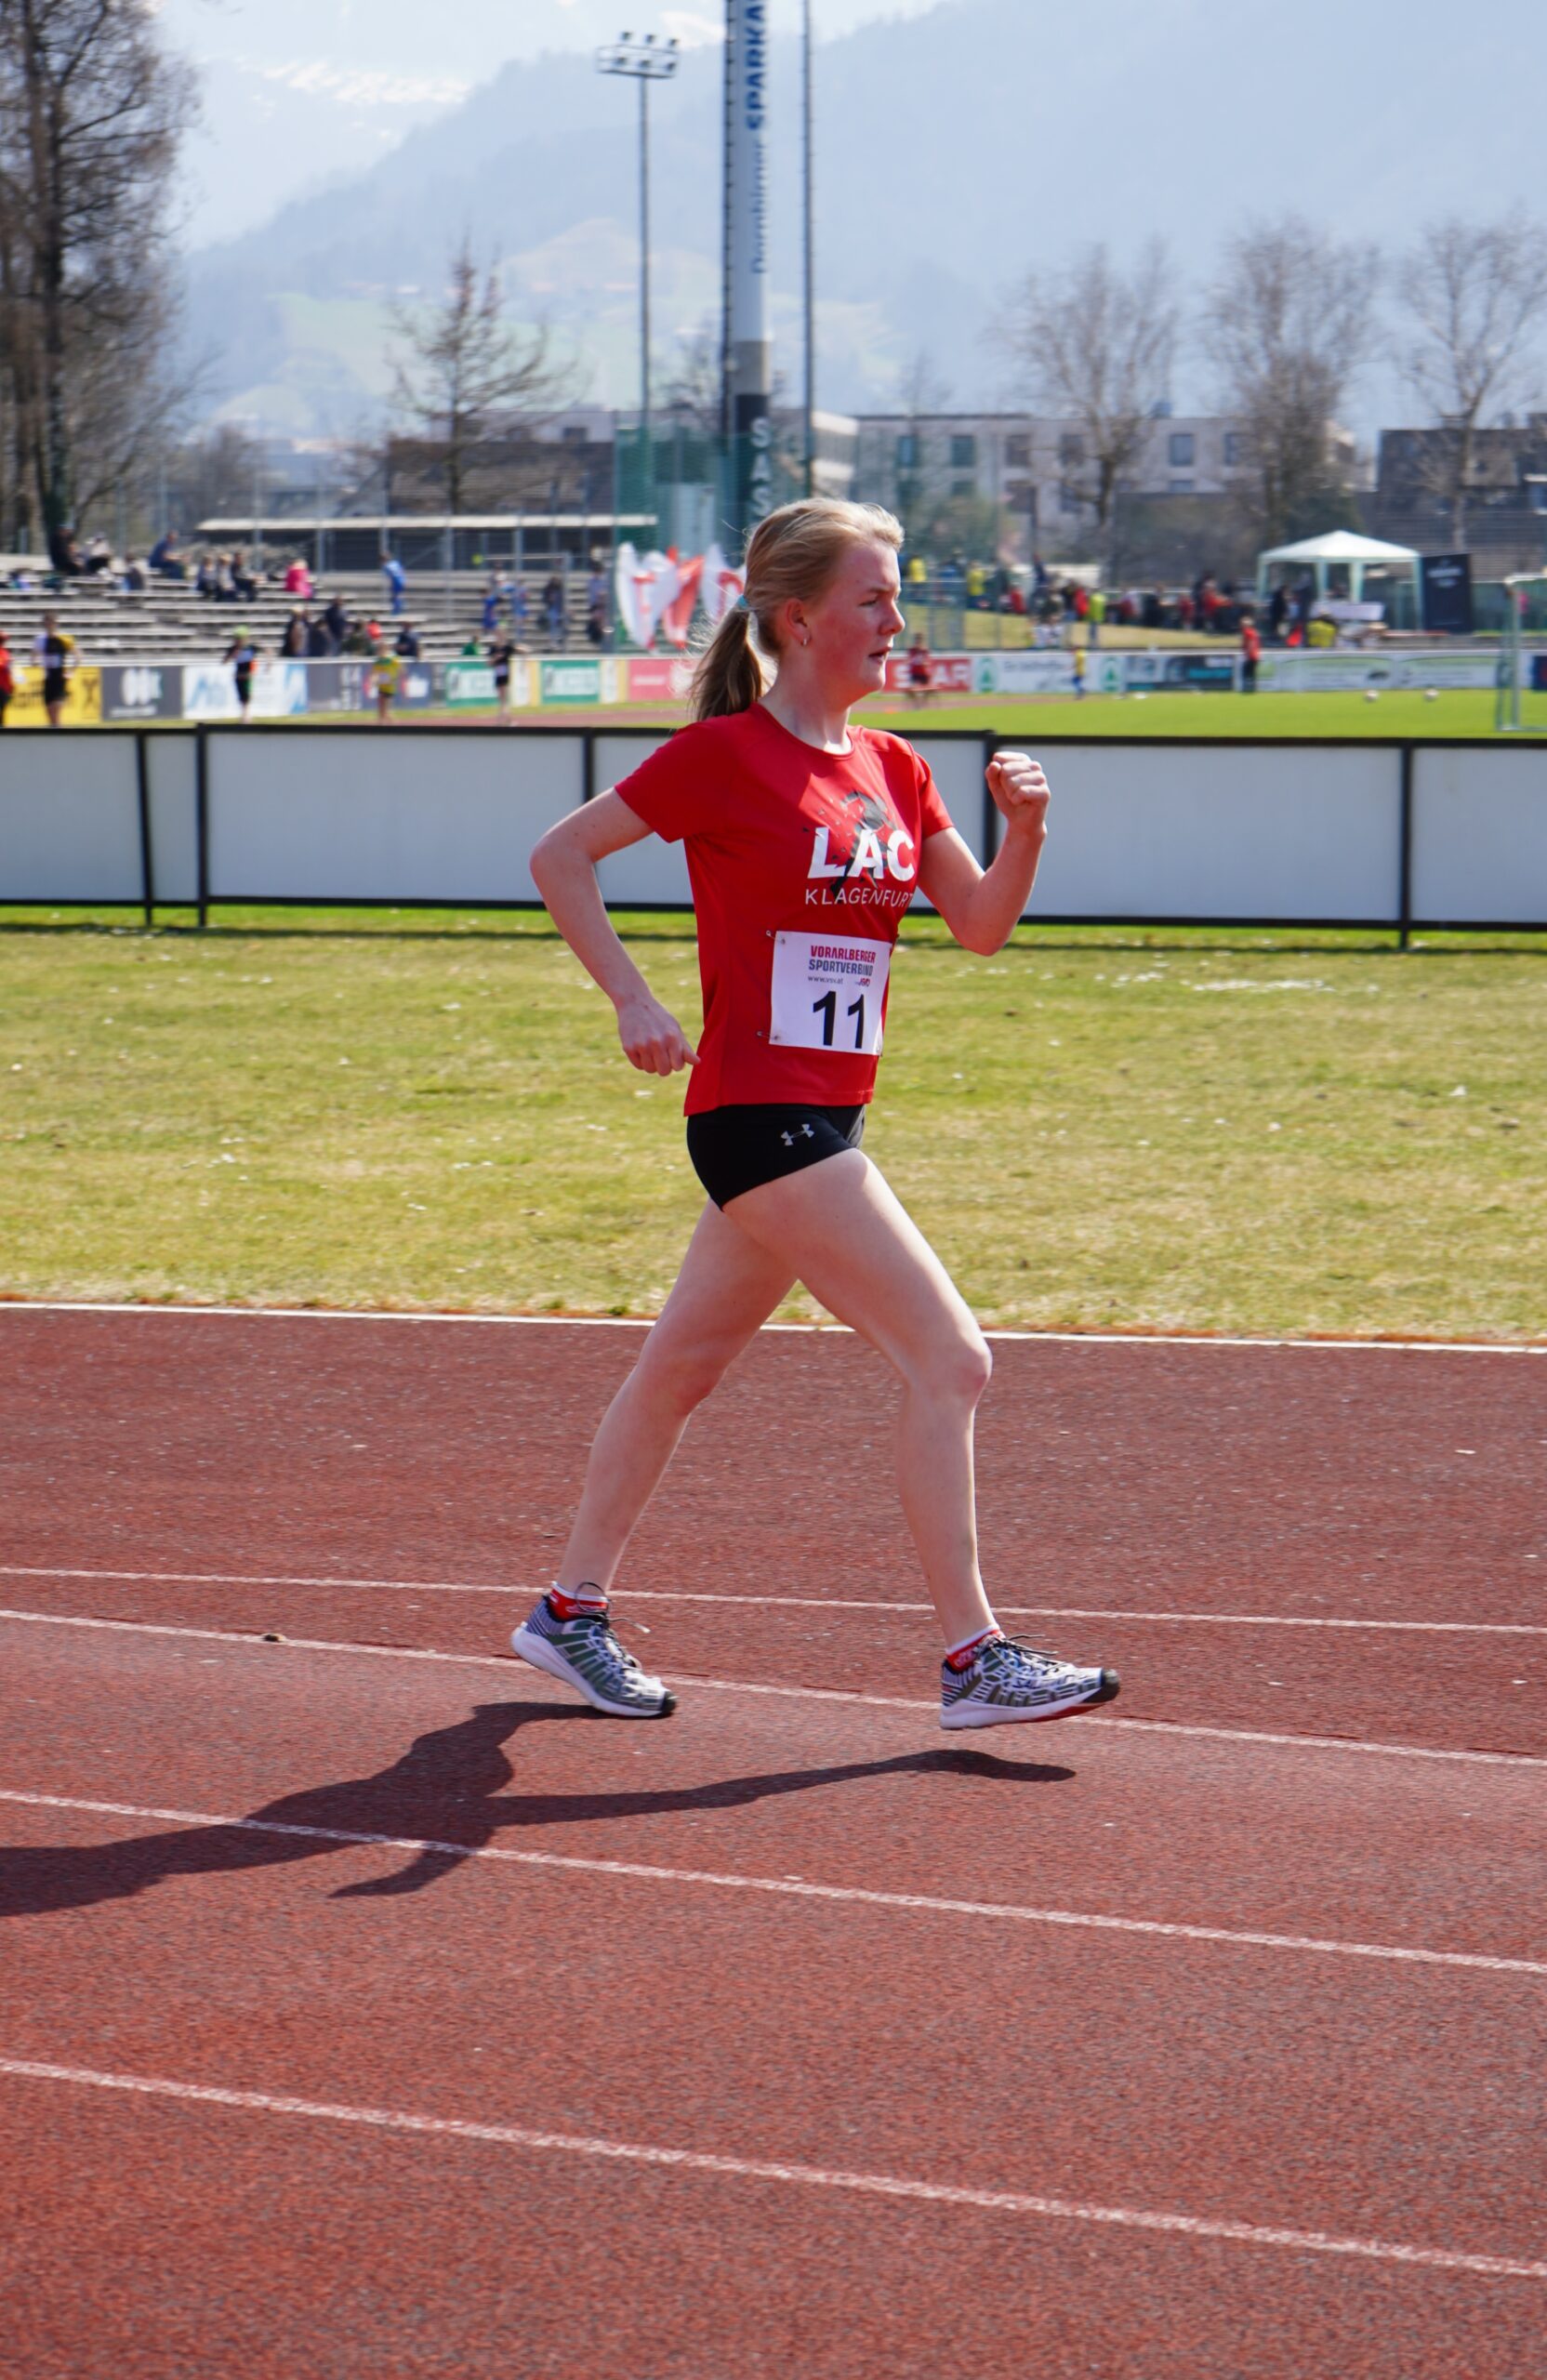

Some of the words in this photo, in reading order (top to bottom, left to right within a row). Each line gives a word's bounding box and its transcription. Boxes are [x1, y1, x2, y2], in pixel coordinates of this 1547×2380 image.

[745, 0, 765, 130] SPARKA
[894, 663, 971, 689] SAR
[807, 826, 915, 882] LAC
[810, 945, 876, 963] VORARLBERGER
[813, 990, 865, 1049] 11
